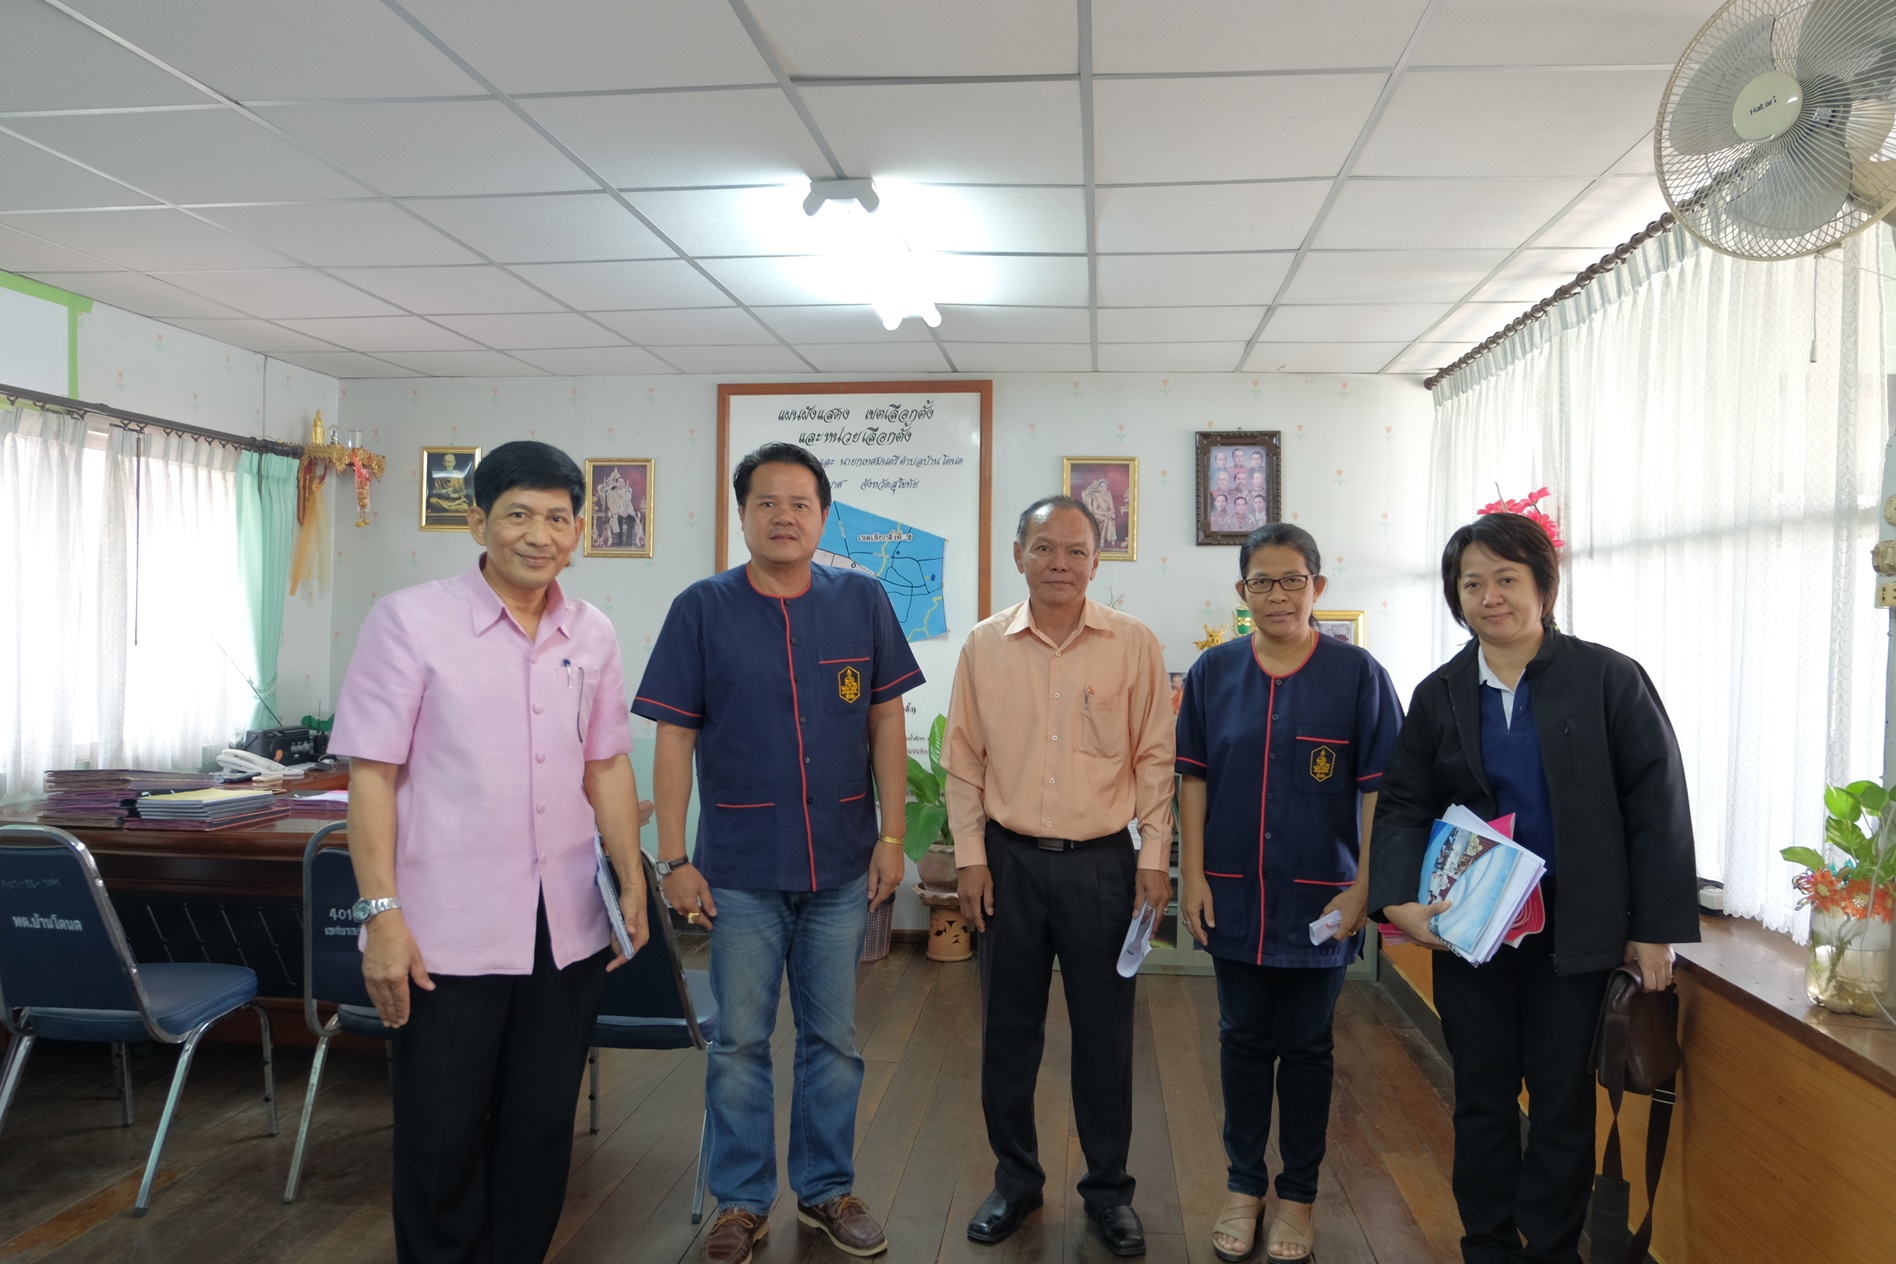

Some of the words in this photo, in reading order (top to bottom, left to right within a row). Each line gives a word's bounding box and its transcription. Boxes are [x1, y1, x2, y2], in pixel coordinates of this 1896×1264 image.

[1749, 95, 1777, 115] Hatari
[778, 404, 850, 423] แผนผังแสดง
[865, 400, 934, 423] เขตเลือกตั้ง
[860, 478, 919, 494] จังหวัดสุโขทัย
